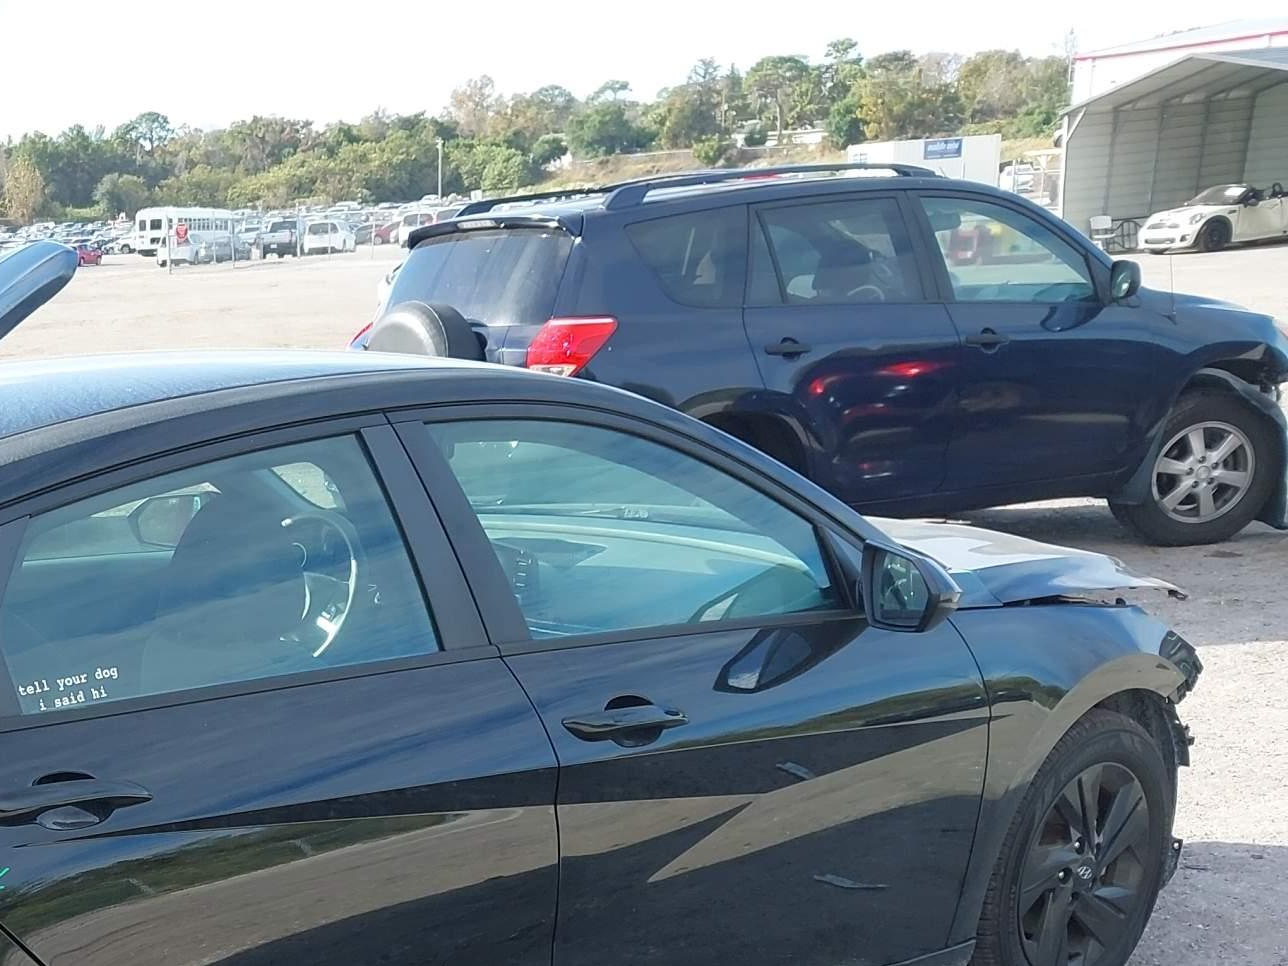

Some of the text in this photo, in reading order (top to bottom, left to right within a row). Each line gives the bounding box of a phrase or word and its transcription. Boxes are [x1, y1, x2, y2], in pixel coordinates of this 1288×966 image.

[18, 666, 119, 696] tell your dog
[39, 685, 108, 711] i said hi
